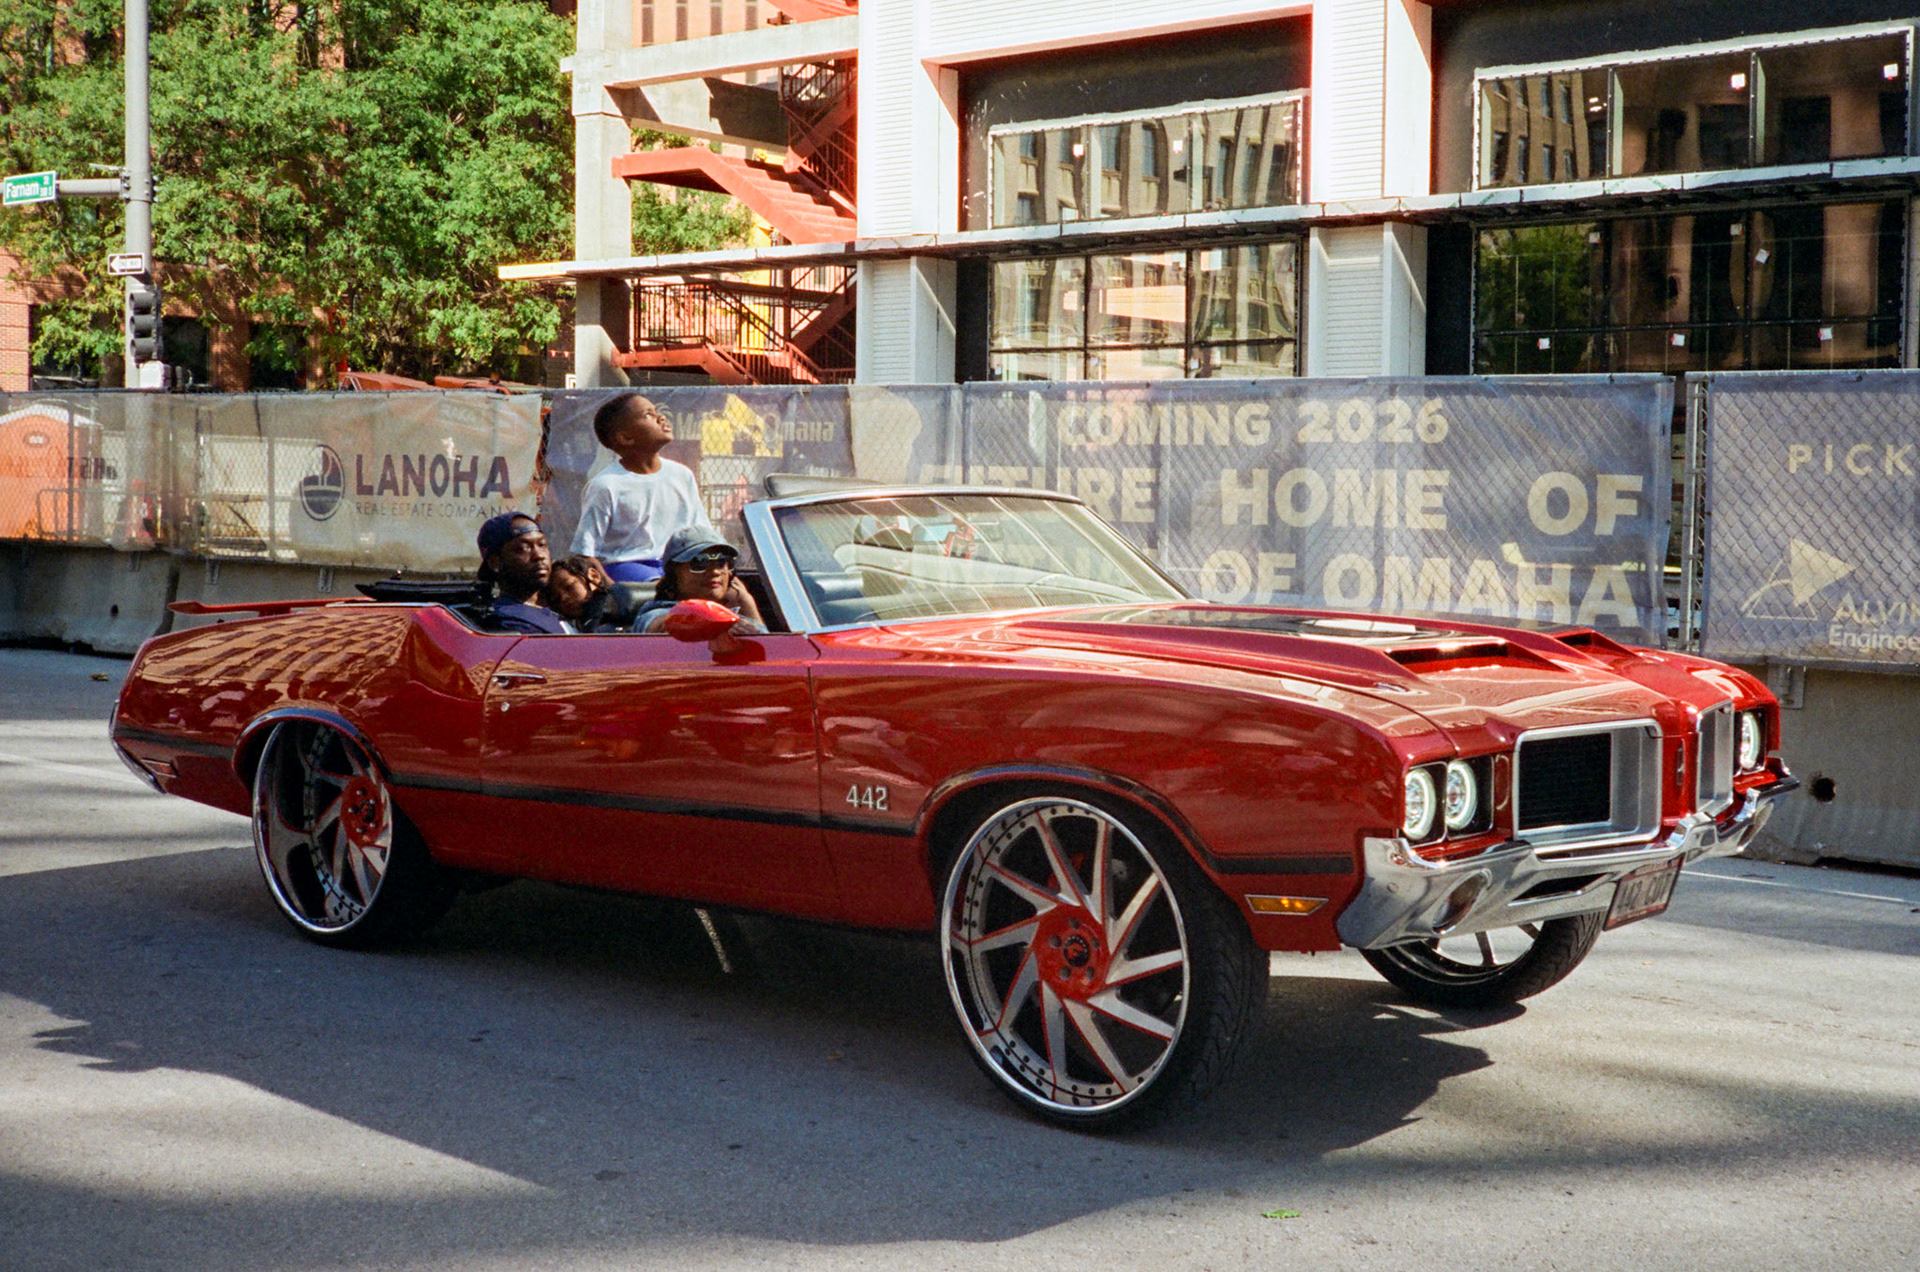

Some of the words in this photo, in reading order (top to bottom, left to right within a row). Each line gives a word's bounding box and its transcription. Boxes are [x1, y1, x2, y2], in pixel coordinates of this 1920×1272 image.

[6, 182, 39, 199] Farnam
[1056, 401, 1272, 447] COMING
[1298, 398, 1450, 445] 2026
[355, 453, 514, 499] LANOHA
[1788, 443, 1916, 476] PICK
[355, 501, 386, 516] REAL
[1220, 468, 1451, 531] HOME
[1526, 470, 1644, 536] OF
[1200, 549, 1297, 605] OF
[1322, 552, 1642, 628] OMAHA
[845, 785, 889, 811] 442
